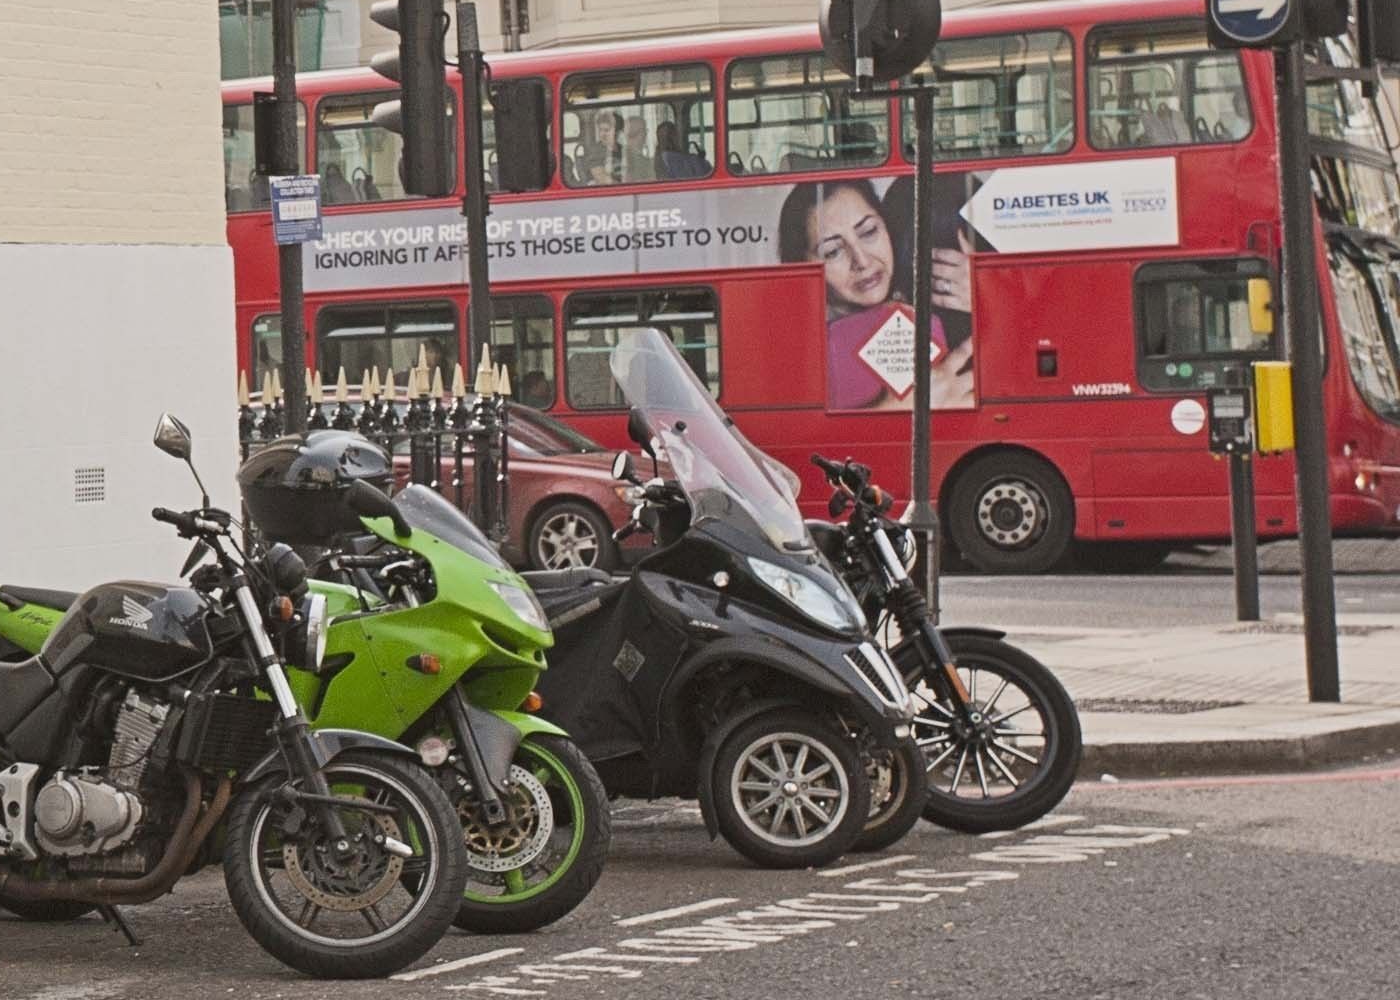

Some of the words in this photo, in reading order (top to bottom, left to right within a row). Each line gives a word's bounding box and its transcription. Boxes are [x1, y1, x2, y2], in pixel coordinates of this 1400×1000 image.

[1085, 191, 1110, 205] UK
[314, 228, 377, 250] CHECK
[381, 226, 434, 246] YOUR
[438, 224, 469, 243] RIS
[485, 221, 513, 239] OF
[517, 217, 564, 237] TYPE
[569, 215, 582, 234] 2
[586, 208, 687, 232] DIABETES.
[315, 248, 408, 269] IGNORING
[413, 246, 429, 263] IT
[434, 241, 516, 264] AFFCTS
[521, 237, 585, 258] THOSE
[591, 230, 677, 252] CLOSEST
[683, 228, 711, 247] TO
[717, 225, 769, 245] YOU.
[109, 616, 149, 630] HONDA
